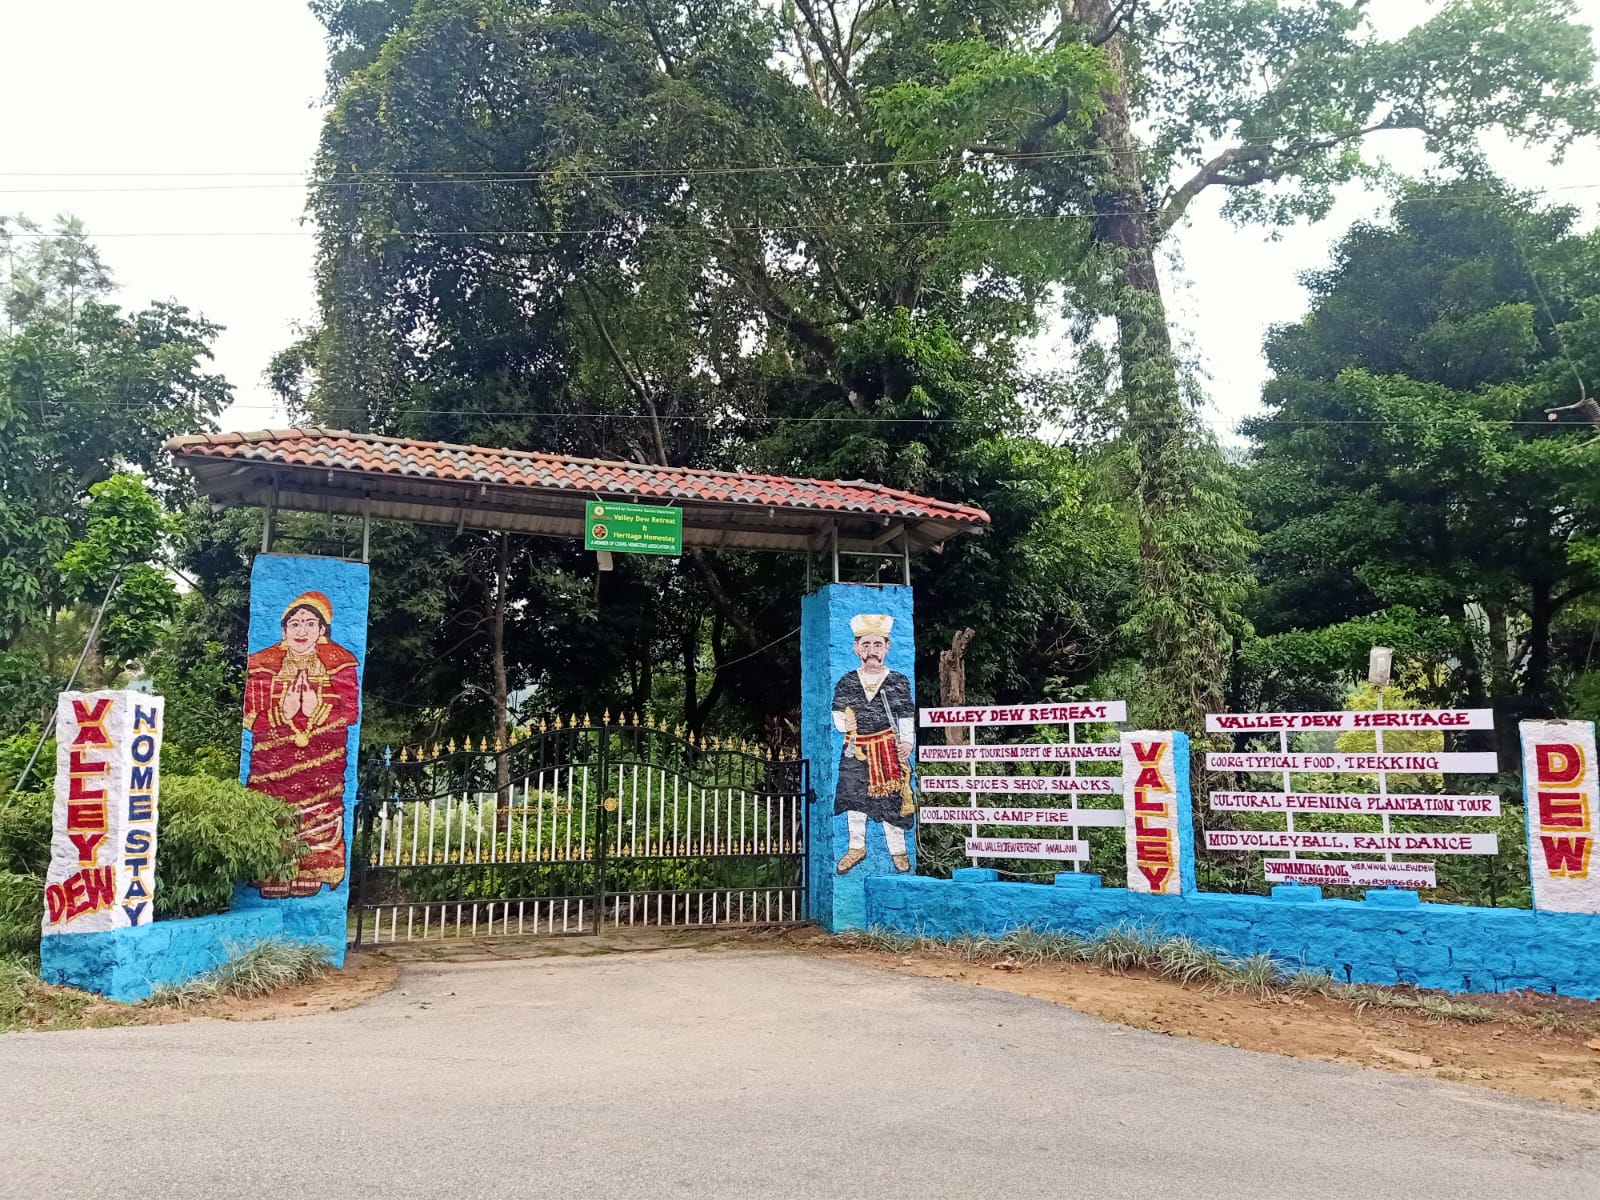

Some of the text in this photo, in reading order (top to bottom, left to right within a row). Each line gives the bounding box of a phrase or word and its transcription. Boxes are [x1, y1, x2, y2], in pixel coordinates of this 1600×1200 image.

[613, 514, 634, 523] Valley
[651, 516, 676, 525] Retreat
[613, 532, 676, 543] Heritage Homestay
[928, 706, 1107, 723] VALLEY DEW RETREAT
[1216, 712, 1470, 729] VALLEY DEW HERITAGE
[921, 749, 963, 759] APPROVED
[966, 748, 977, 759] BY
[980, 748, 1018, 758] TOURISM
[1020, 747, 1041, 758] DEPT
[1042, 747, 1053, 758] OF
[1211, 757, 1243, 767] COORG
[1245, 756, 1299, 768] TYPICAL
[1344, 756, 1439, 770] TREKKING
[966, 779, 1009, 790] SPICES
[46, 698, 114, 924] VALLEY DEW
[1213, 794, 1492, 812] CULTURAL EVENING PLANTATION TOUR
[1535, 744, 1593, 879] DEW
[1131, 742, 1174, 894] VALLEY
[1208, 834, 1238, 846] MUD
[1353, 836, 1402, 849] RAIN
[1405, 836, 1473, 850] DANCE
[122, 829, 154, 927] STAY
